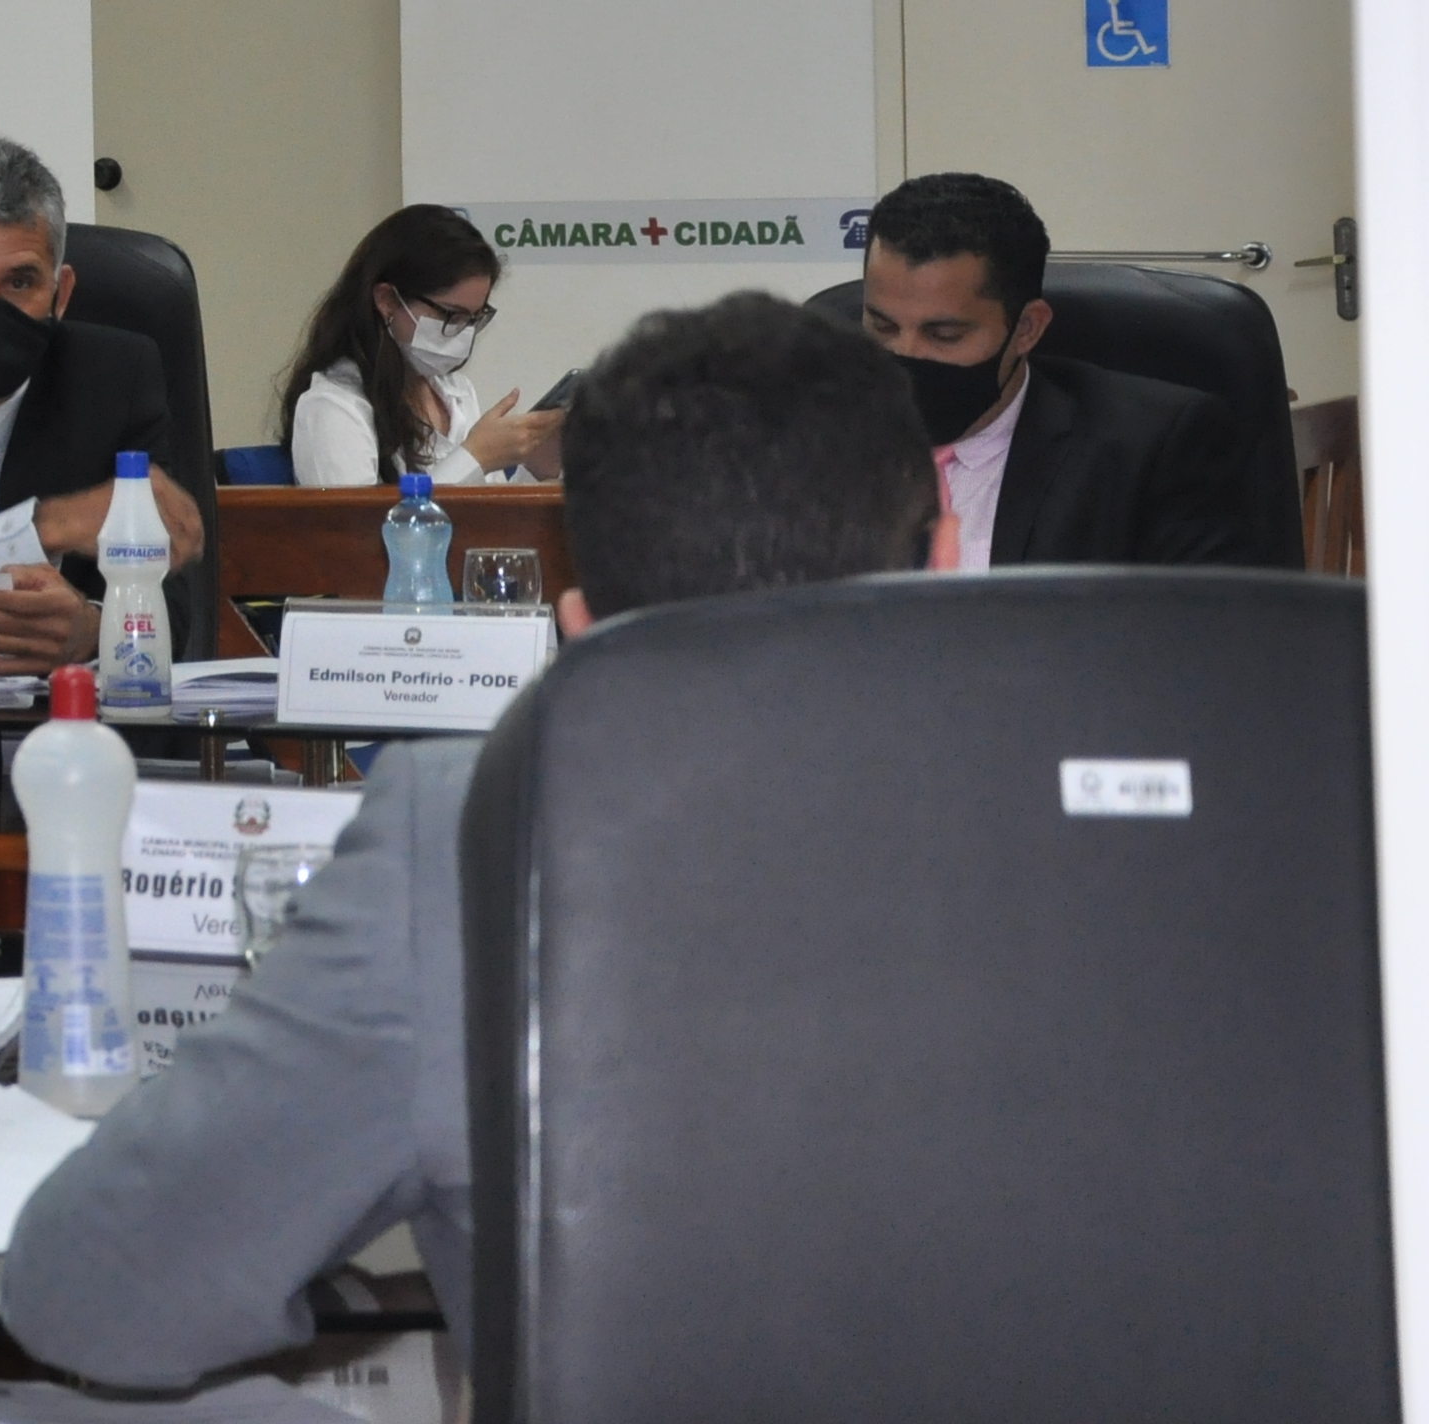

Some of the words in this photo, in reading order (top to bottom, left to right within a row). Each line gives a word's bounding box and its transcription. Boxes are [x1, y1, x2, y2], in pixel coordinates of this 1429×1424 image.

[495, 218, 637, 247] CÂMARA
[674, 215, 804, 246] CIDADÃ
[124, 620, 155, 632] GEL
[469, 674, 519, 688] PODE
[383, 690, 439, 703] Vereador
